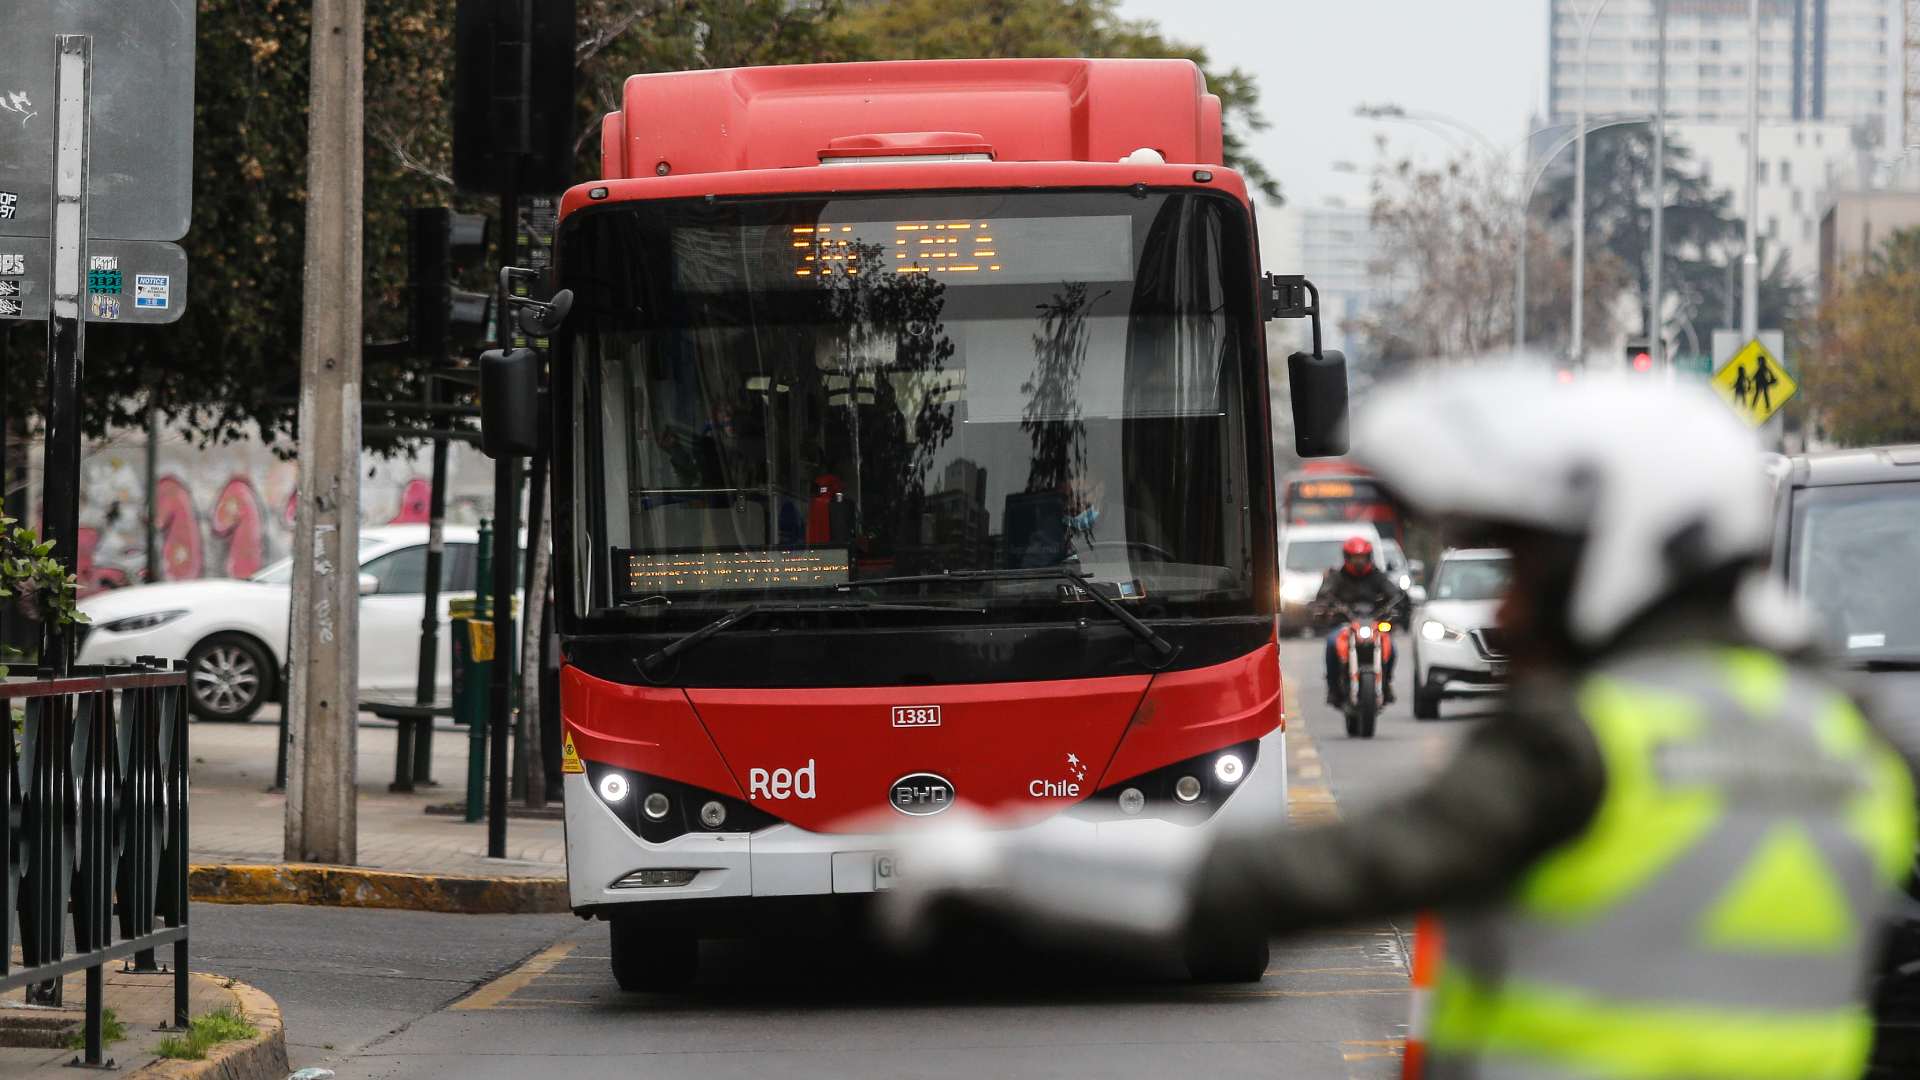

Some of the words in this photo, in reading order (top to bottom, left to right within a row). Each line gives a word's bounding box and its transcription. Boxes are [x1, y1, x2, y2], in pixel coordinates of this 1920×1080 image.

[897, 708, 937, 724] 1381
[750, 758, 816, 800] Red
[1029, 779, 1080, 797] Chile
[896, 786, 947, 804] BYD
